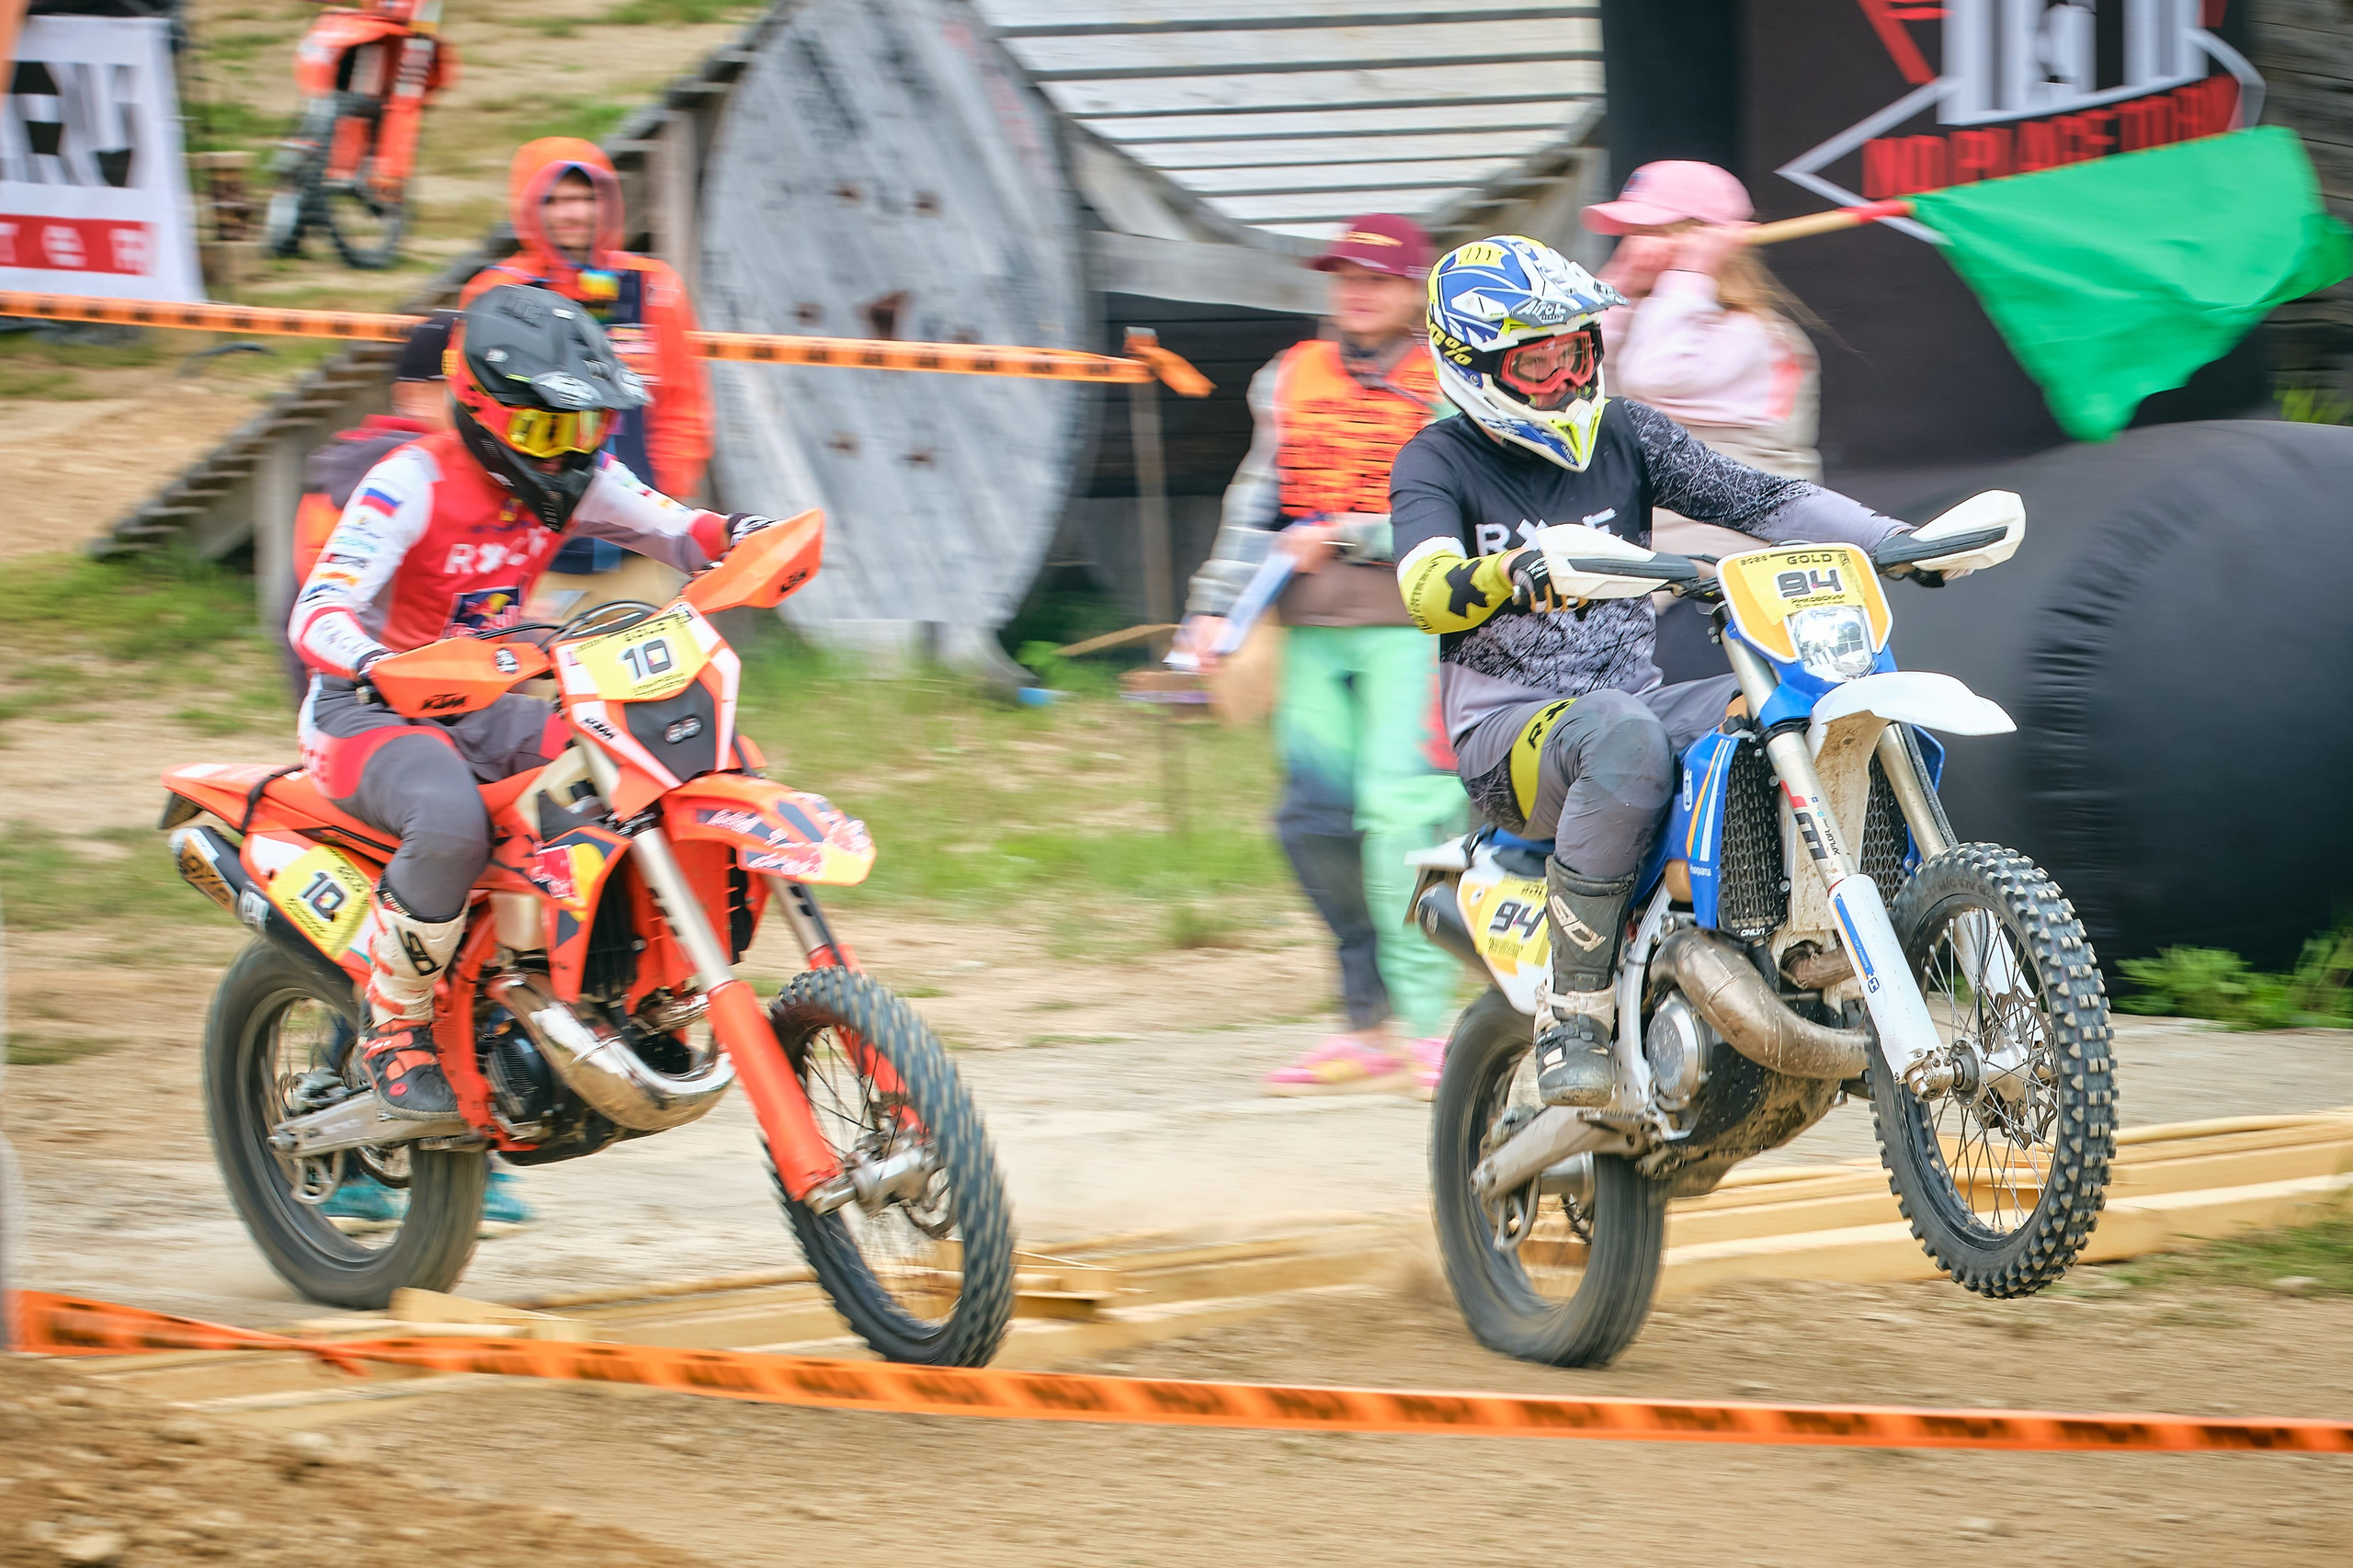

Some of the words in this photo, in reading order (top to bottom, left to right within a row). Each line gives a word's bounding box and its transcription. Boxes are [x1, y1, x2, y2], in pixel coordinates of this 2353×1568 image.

[1787, 553, 1833, 565] GOLD
[1777, 569, 1842, 597] 94
[620, 639, 673, 683] 10
[420, 694, 469, 710] KTM
[300, 870, 345, 923] 10
[1488, 901, 1546, 938] 94
